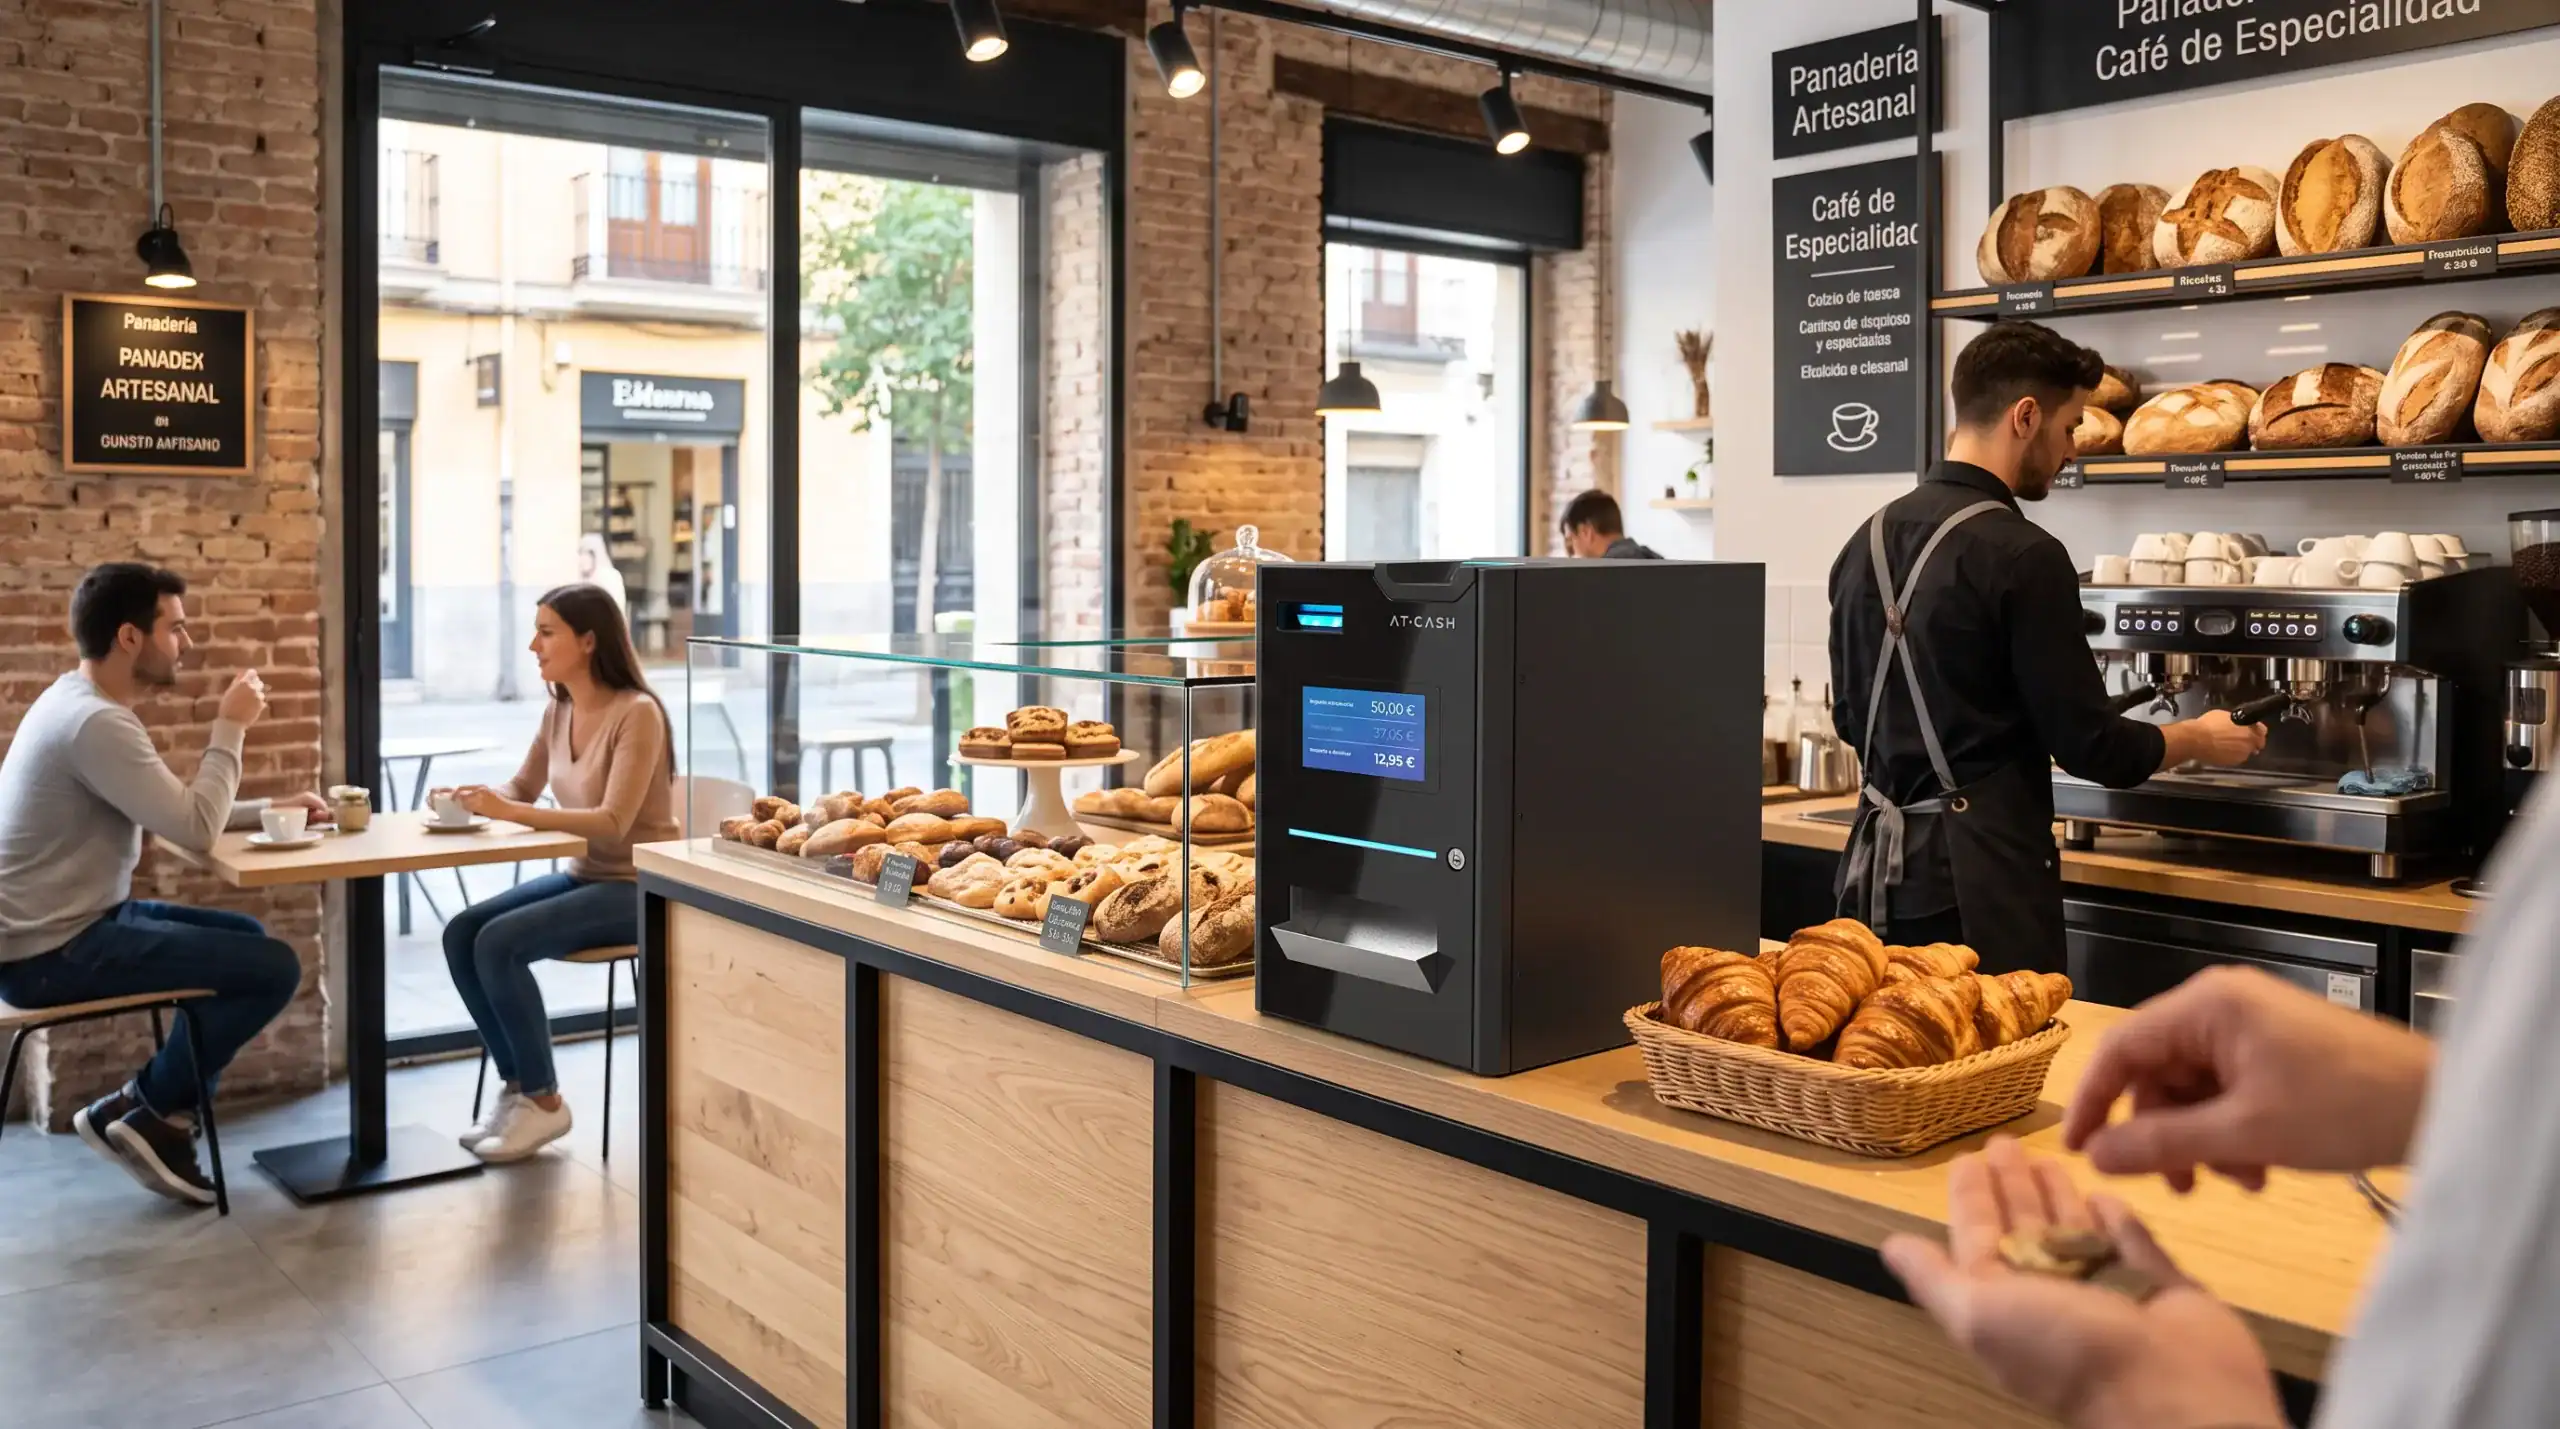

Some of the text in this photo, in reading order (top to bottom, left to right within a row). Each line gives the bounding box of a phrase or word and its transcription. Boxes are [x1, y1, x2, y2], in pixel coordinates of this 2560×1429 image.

[2118, 0, 2256, 29] Pana
[2095, 34, 2169, 81] Café
[2181, 28, 2223, 66] de
[1790, 43, 1919, 97] Panadería
[1792, 84, 1916, 137] Artesanal
[1812, 187, 1896, 222] Café de
[1846, 289, 1860, 304] de
[124, 312, 198, 334] Panadería
[1843, 316, 1858, 331] de
[1816, 339, 1823, 354] y
[119, 346, 204, 371] PANADEX
[1850, 363, 1858, 376] e
[100, 377, 220, 404] ARTESANAL
[1371, 700, 1404, 716] 50,00
[1406, 704, 1416, 717] €
[1373, 726, 1415, 743] 37,05 €
[1373, 752, 1416, 769] 12,95 €
